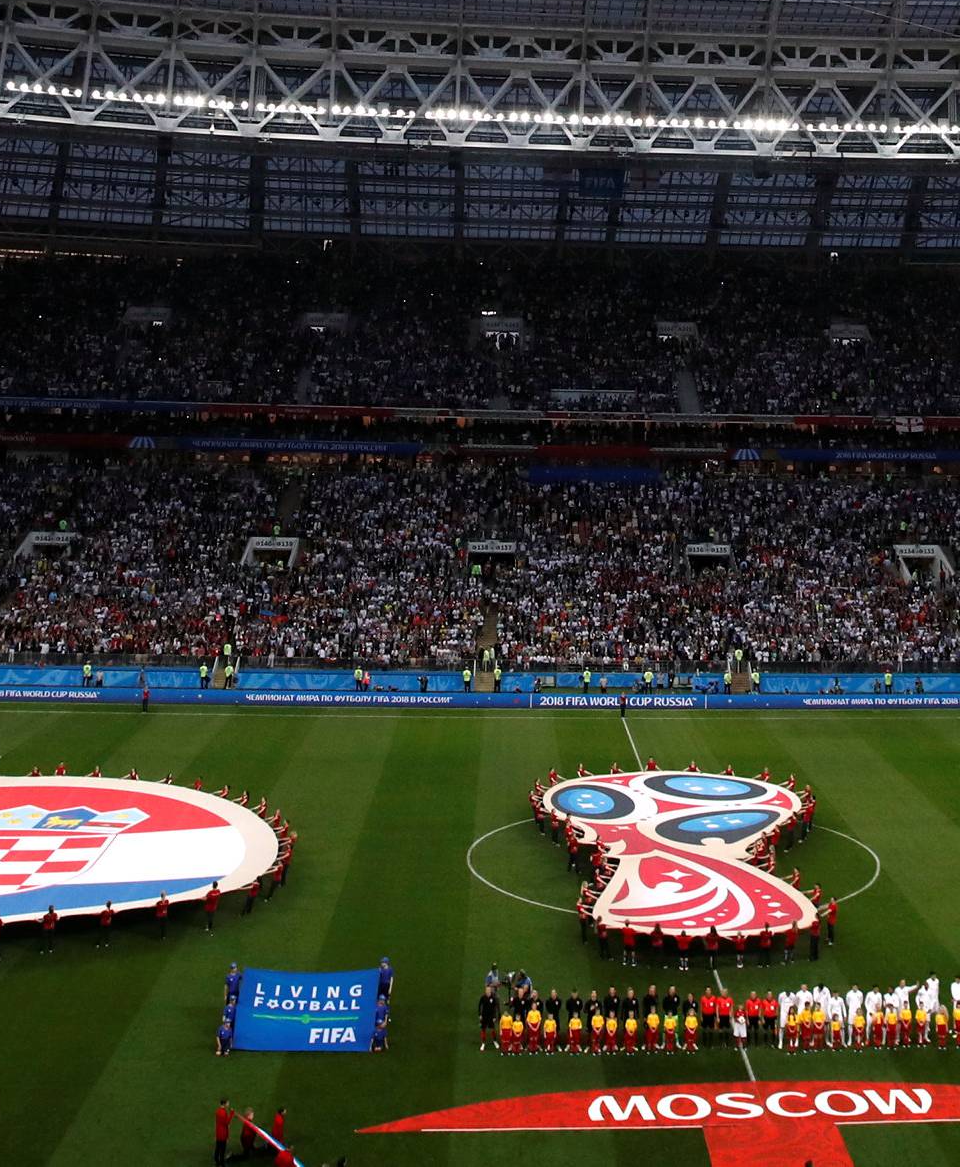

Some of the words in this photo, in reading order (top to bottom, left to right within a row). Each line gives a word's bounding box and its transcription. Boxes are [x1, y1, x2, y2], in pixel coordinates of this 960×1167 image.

[5, 690, 22, 698] FIFA
[22, 690, 50, 698] WORLD
[51, 690, 68, 698] CUP
[68, 691, 98, 699] RUSSIA
[246, 694, 294, 702] ЧЕМПИОНАТ
[296, 694, 320, 702] МИРА
[321, 694, 333, 702] ПО
[334, 695, 372, 703] ФУТБОЛУ
[373, 695, 390, 703] FIFA
[540, 696, 564, 706] 2018
[565, 696, 588, 706] FIFA
[589, 696, 628, 706] WORL
[629, 696, 653, 707] CUP
[654, 696, 694, 707] RUSSIA
[803, 698, 851, 706] ЧЕМПИОНАТ
[851, 698, 874, 706] МИРА
[875, 698, 886, 706] ПО
[255, 982, 363, 999] LIVING
[253, 996, 361, 1012] FOOTBALL
[308, 1026, 357, 1044] FIFA
[587, 1088, 934, 1122] MOSCOW
